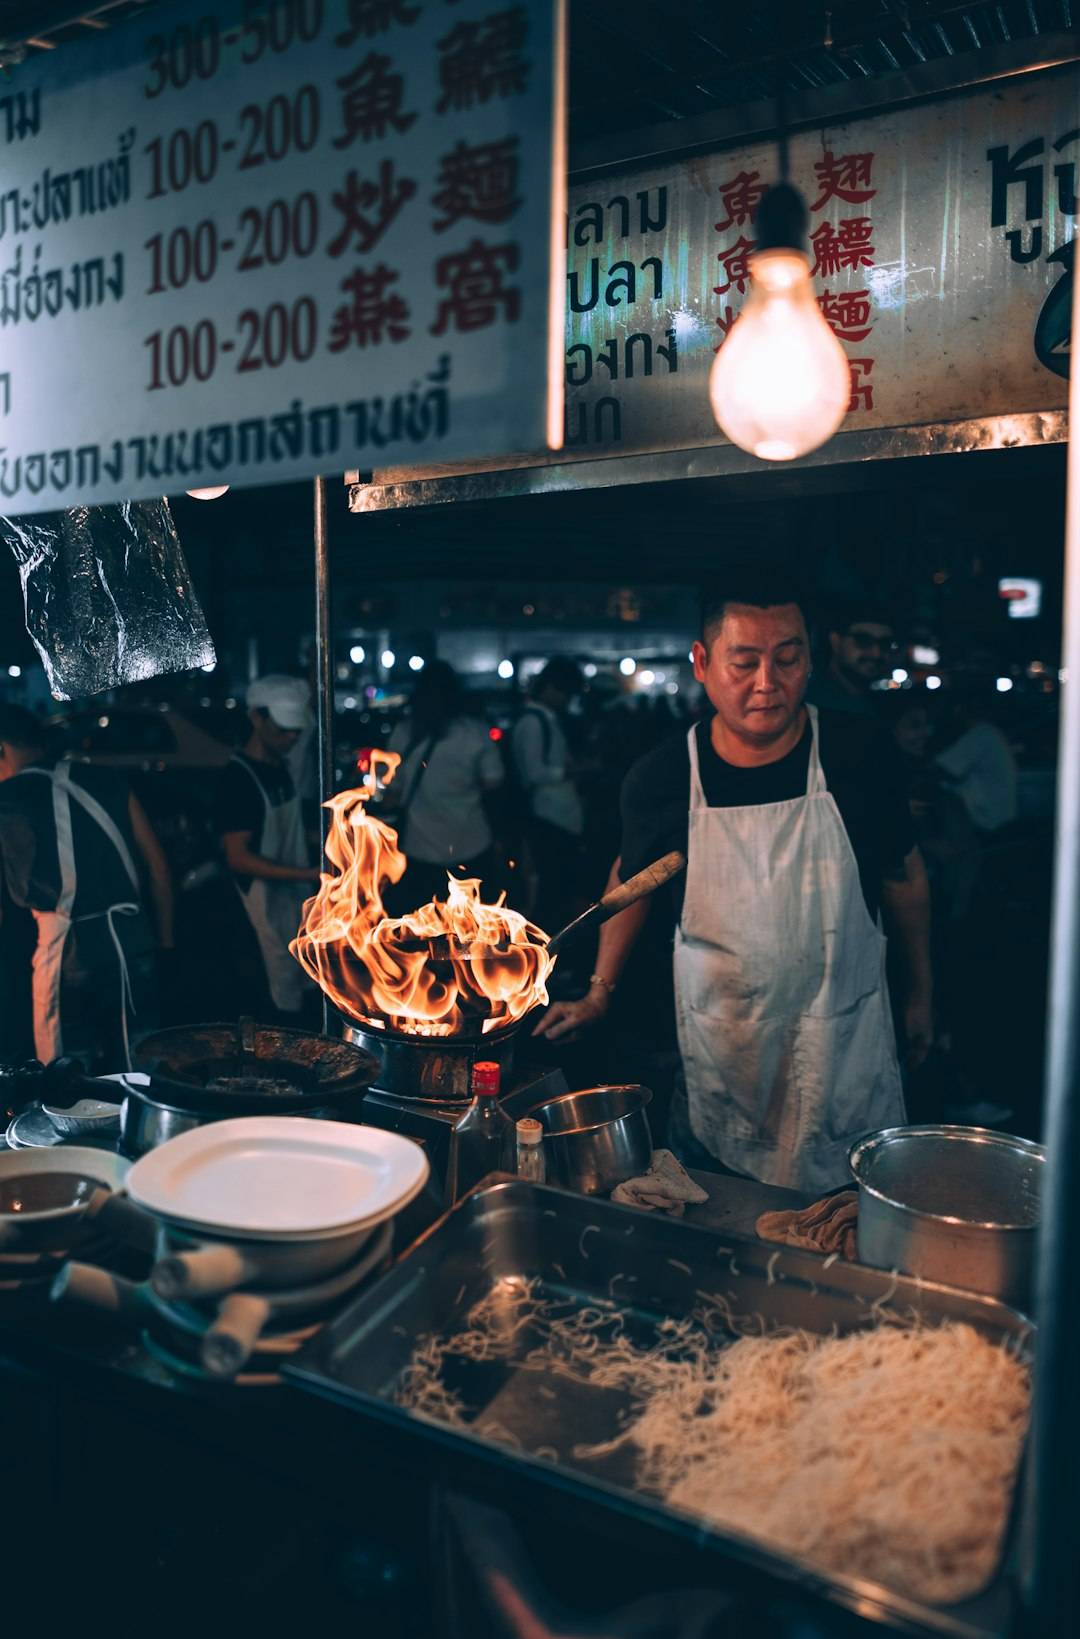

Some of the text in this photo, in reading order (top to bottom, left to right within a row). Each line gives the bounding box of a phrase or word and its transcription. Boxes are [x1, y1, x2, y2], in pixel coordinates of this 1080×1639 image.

[143, 0, 324, 99] 300-500
[143, 83, 321, 200] 100-200
[143, 190, 320, 296] 100-200
[327, 135, 523, 258] 炒麵
[565, 186, 668, 250] ลาม
[143, 296, 318, 392] 100-200
[327, 240, 523, 354] 燕窩
